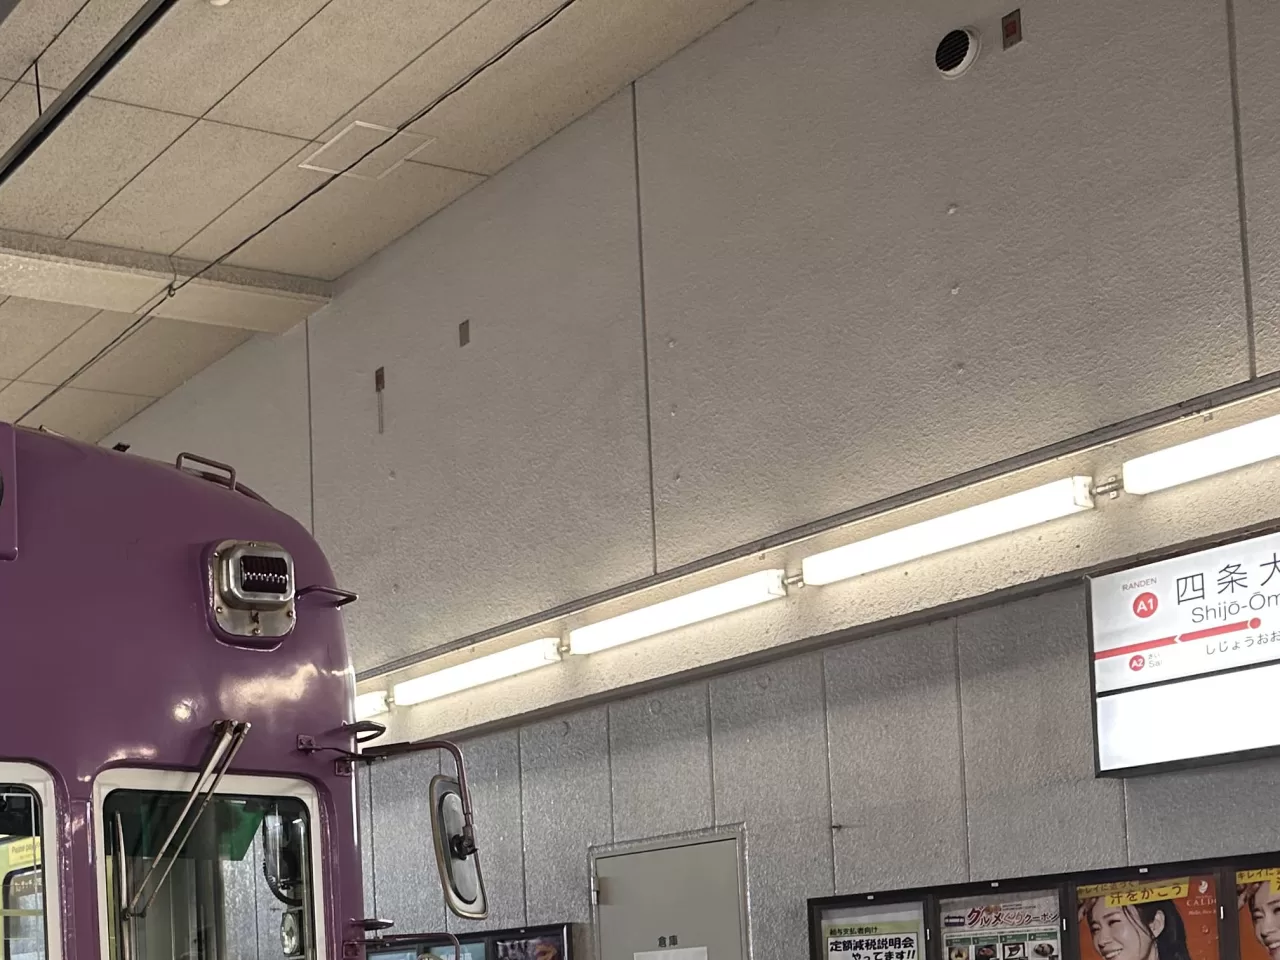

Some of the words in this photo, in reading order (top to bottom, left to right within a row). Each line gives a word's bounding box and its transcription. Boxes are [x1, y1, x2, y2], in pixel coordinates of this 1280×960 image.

[1122, 577, 1158, 591] RANDEN
[1176, 552, 1280, 606] 四条大
[1136, 598, 1155, 614] A1
[1131, 658, 1144, 668] A2
[1111, 883, 1183, 905] 汗をかこう
[658, 935, 678, 947] 倉庫
[830, 937, 915, 952] 定額減税説明会
